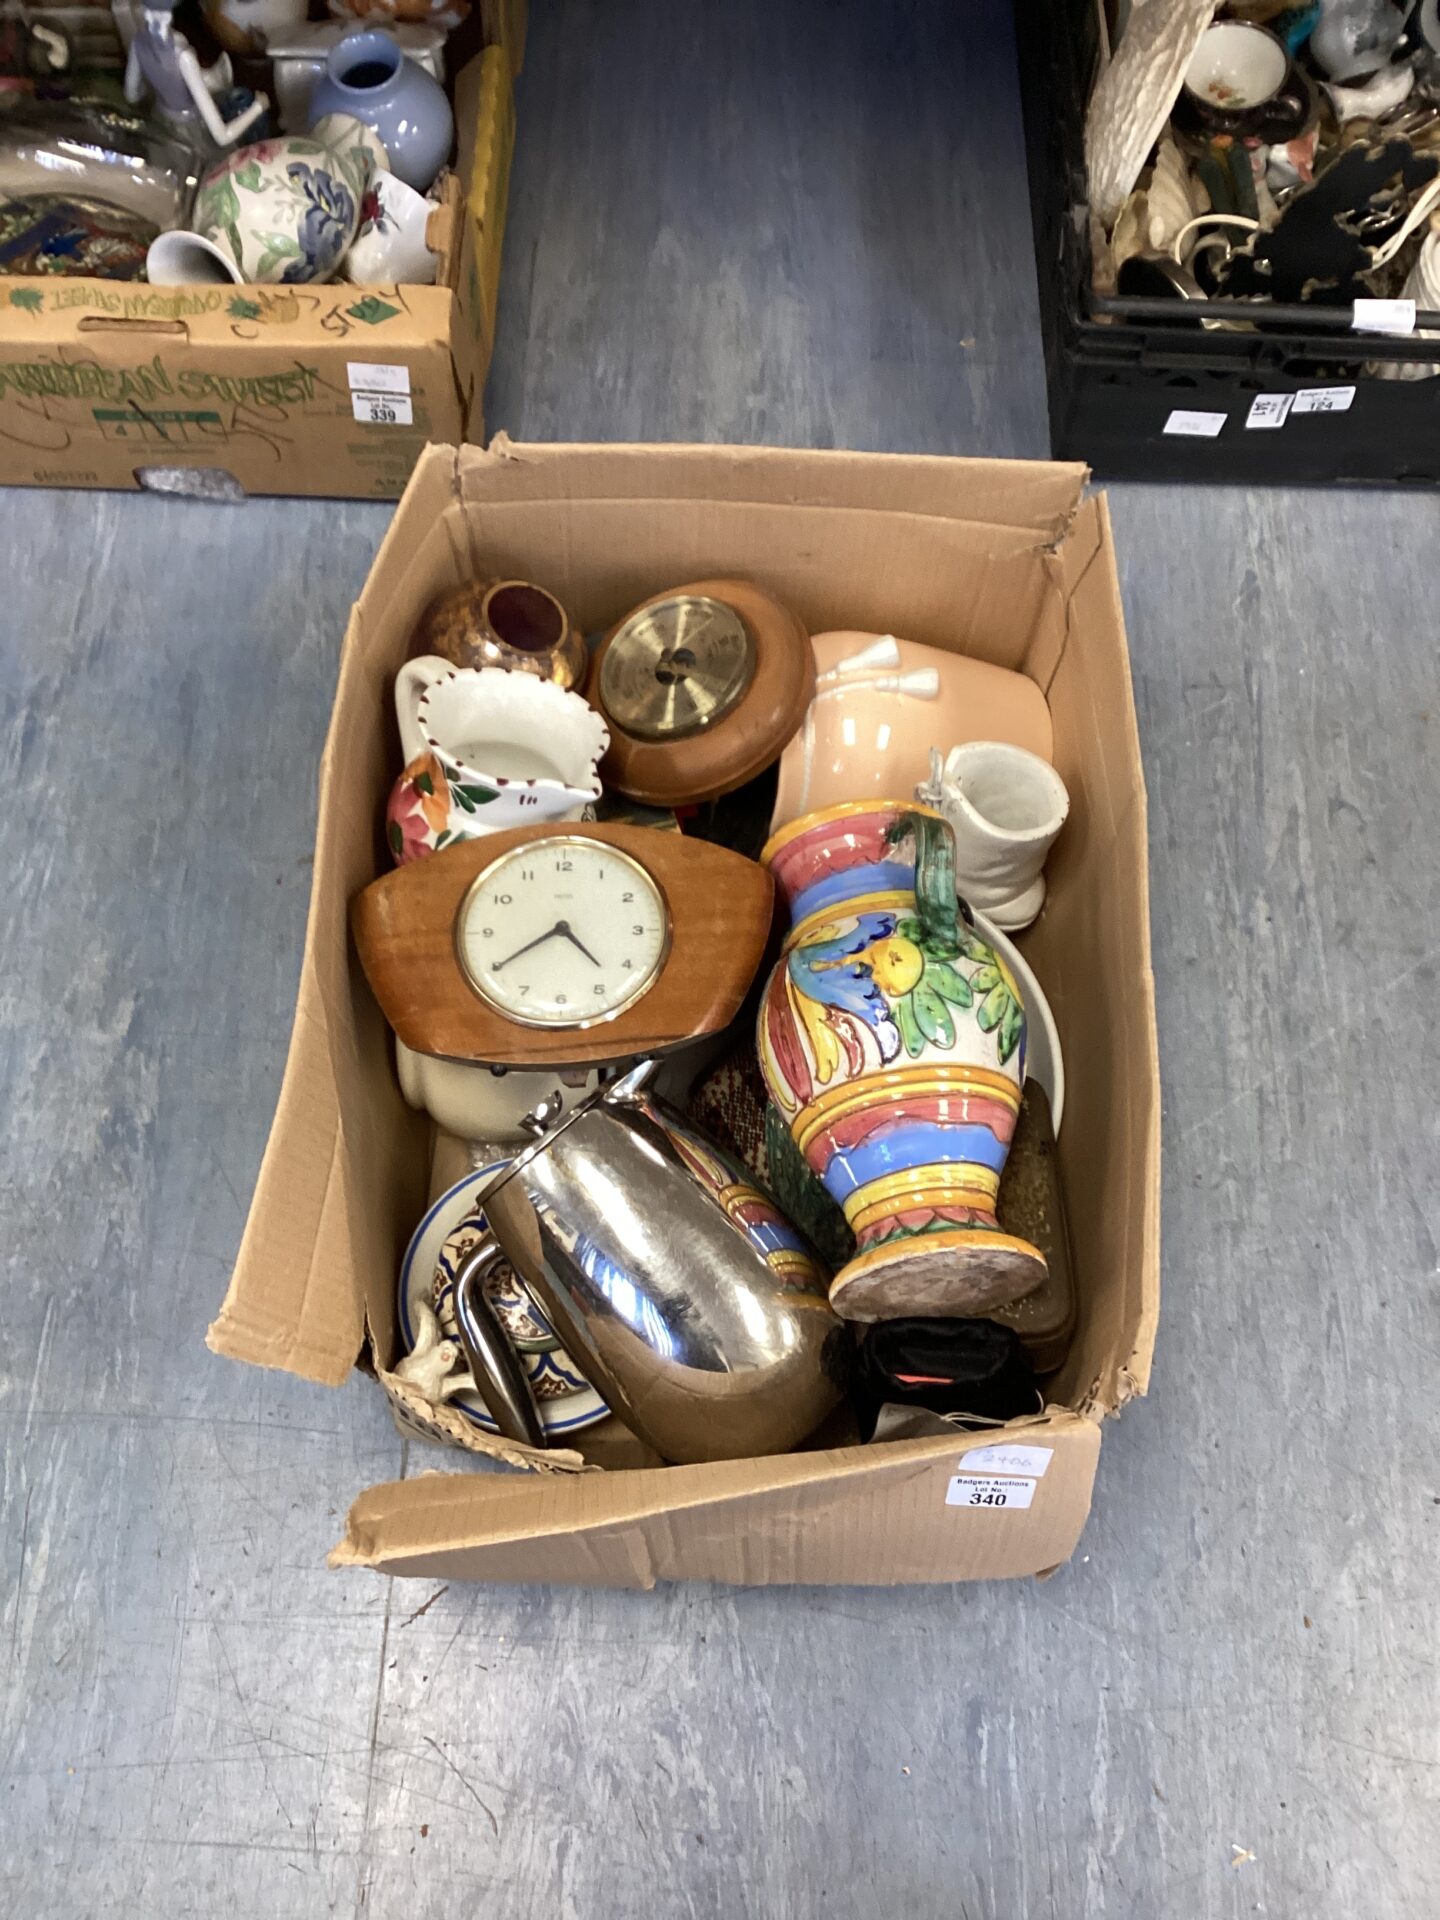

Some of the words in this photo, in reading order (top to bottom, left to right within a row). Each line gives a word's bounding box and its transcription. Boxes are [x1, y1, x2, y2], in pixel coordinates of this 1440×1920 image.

[370, 409, 396, 422] 339
[556, 862, 573, 871] 12
[522, 870, 534, 880] 11
[494, 895, 512, 905] 10
[622, 893, 634, 903] 2
[482, 928, 494, 938] 9
[632, 926, 644, 936] 3
[622, 960, 632, 969] 4
[518, 986, 530, 996] 7
[594, 985, 605, 995] 5
[555, 994, 567, 1004] 6
[957, 1478, 991, 1486] Badgers
[993, 1480, 1029, 1488] Auctions
[969, 1493, 1007, 1507] 340
